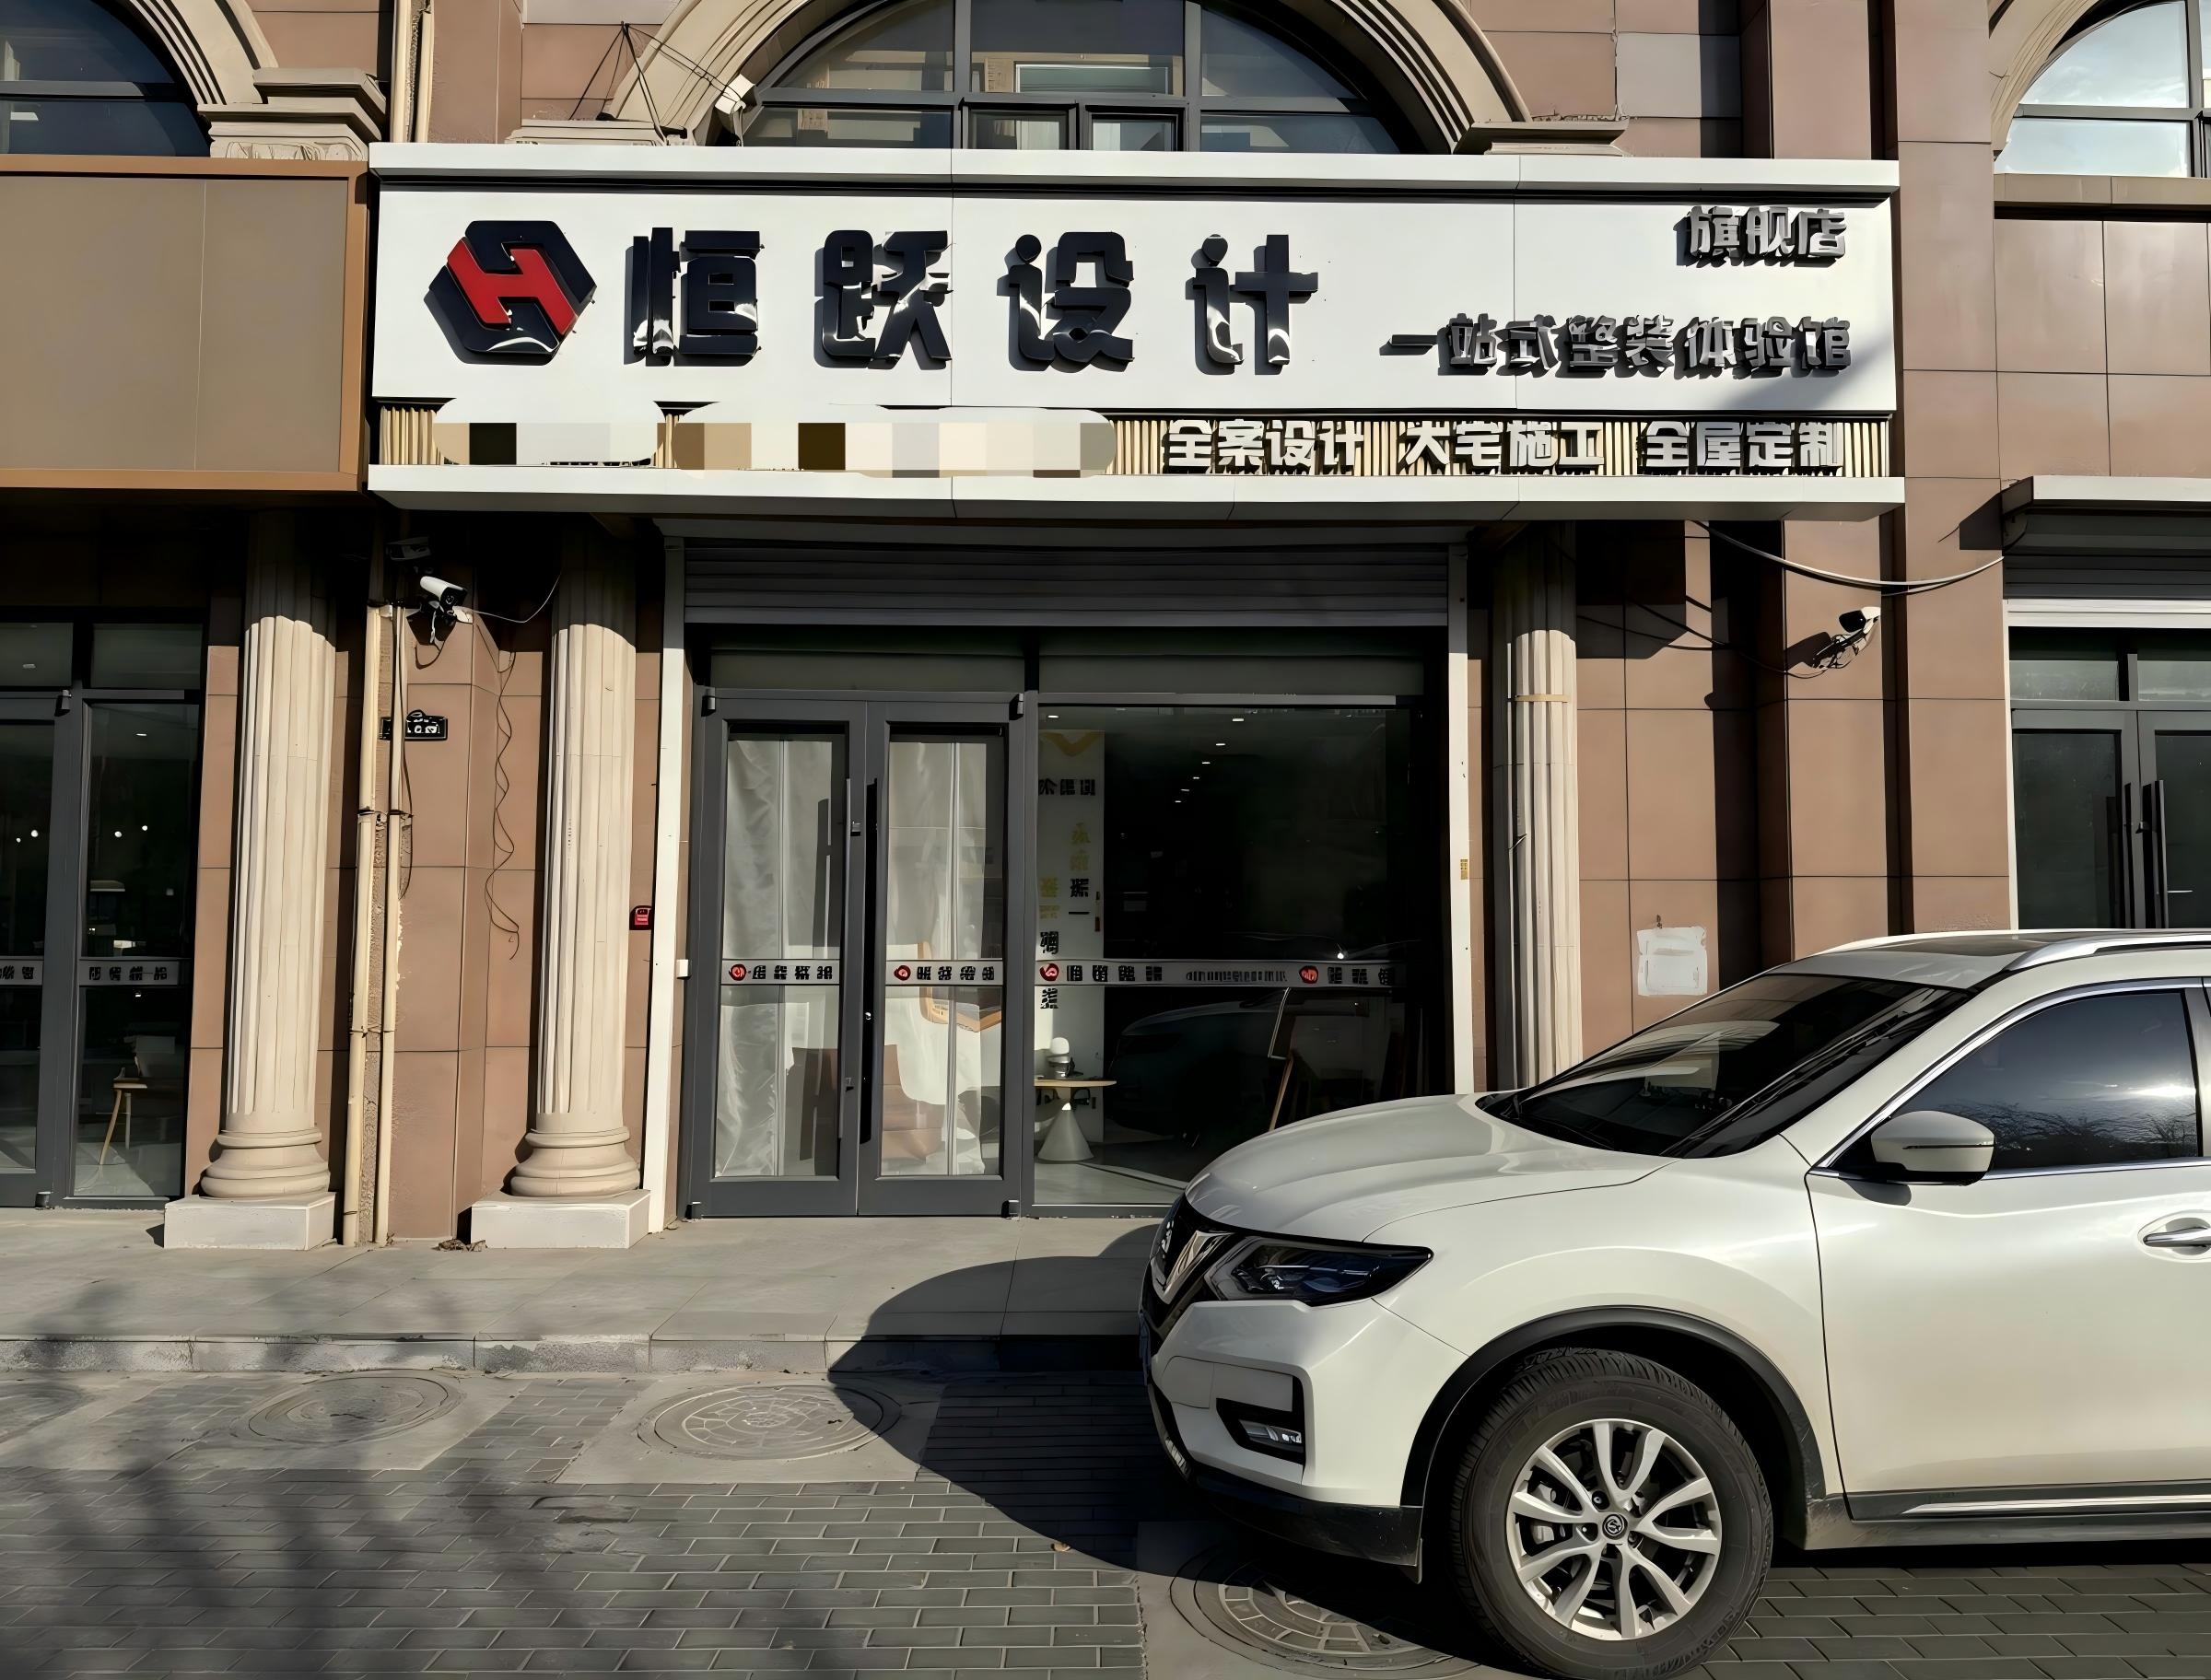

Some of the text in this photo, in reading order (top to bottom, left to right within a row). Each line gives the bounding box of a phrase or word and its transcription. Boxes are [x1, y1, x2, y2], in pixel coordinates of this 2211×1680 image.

[1689, 205, 1847, 258] 旗舰店
[632, 227, 1319, 367] 恒跃设计
[1389, 313, 1852, 370] 一站式整装体验馆
[1168, 419, 1845, 468] 全案设计 大宅施工 全屋定制
